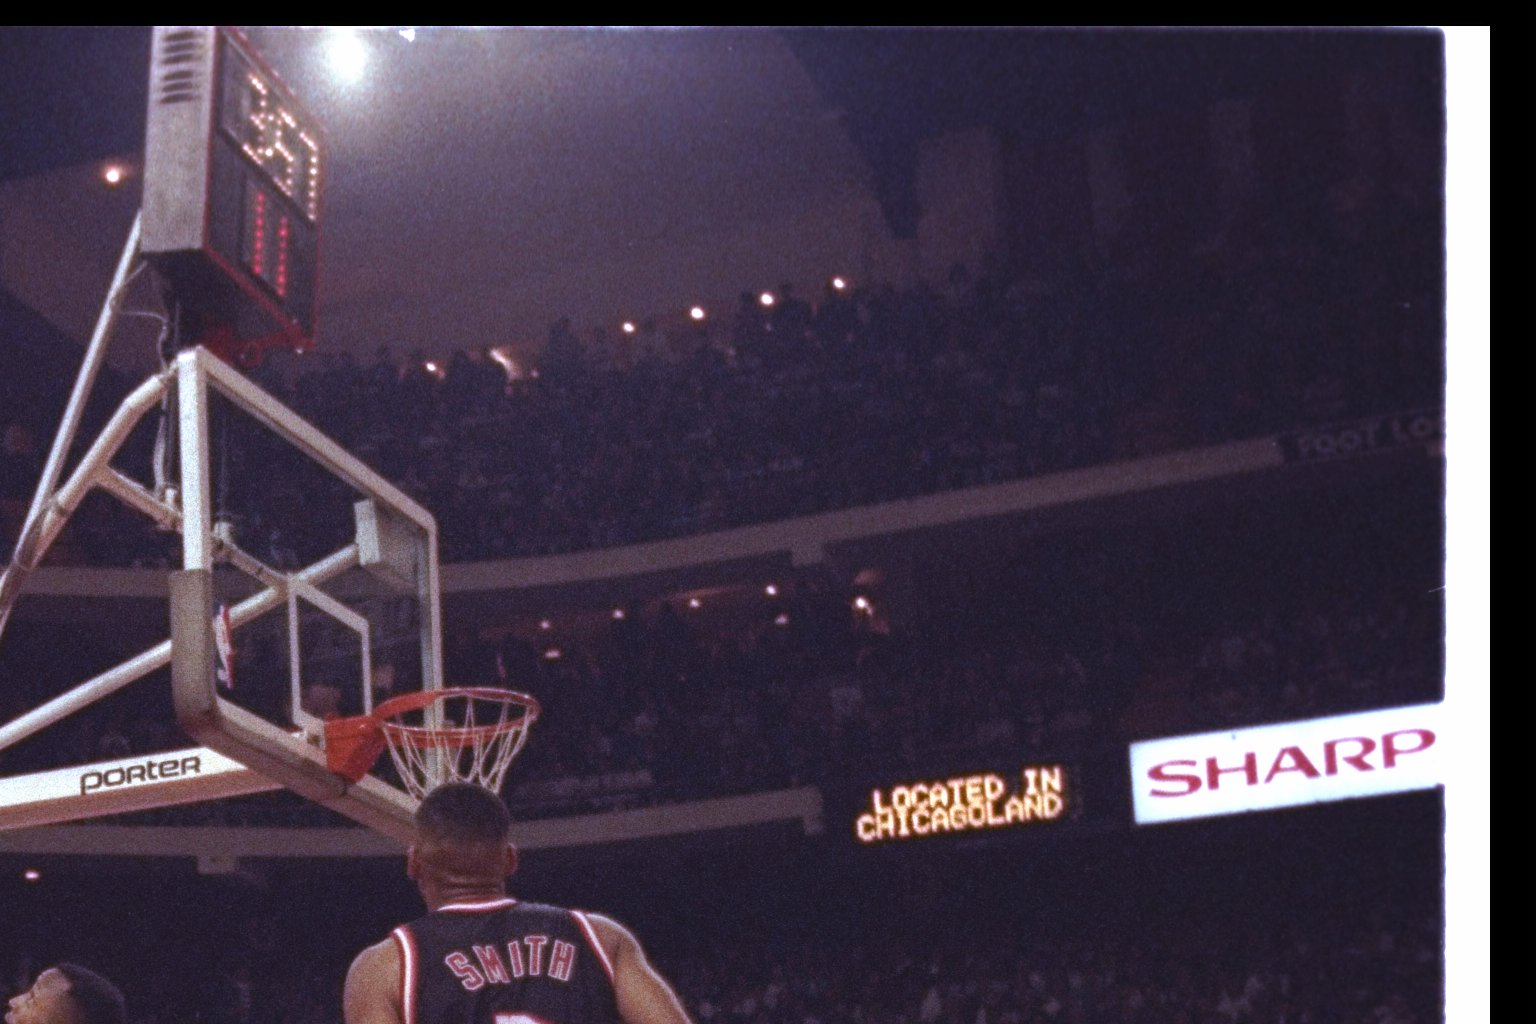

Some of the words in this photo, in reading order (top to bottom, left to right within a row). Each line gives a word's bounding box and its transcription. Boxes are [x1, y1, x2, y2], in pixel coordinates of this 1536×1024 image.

[1146, 728, 1437, 798] SHARP
[856, 792, 1063, 842] CHICAGOLAND
[872, 774, 1004, 815] LOCATED
[1023, 767, 1062, 796] IN
[444, 935, 576, 991] SMITH
